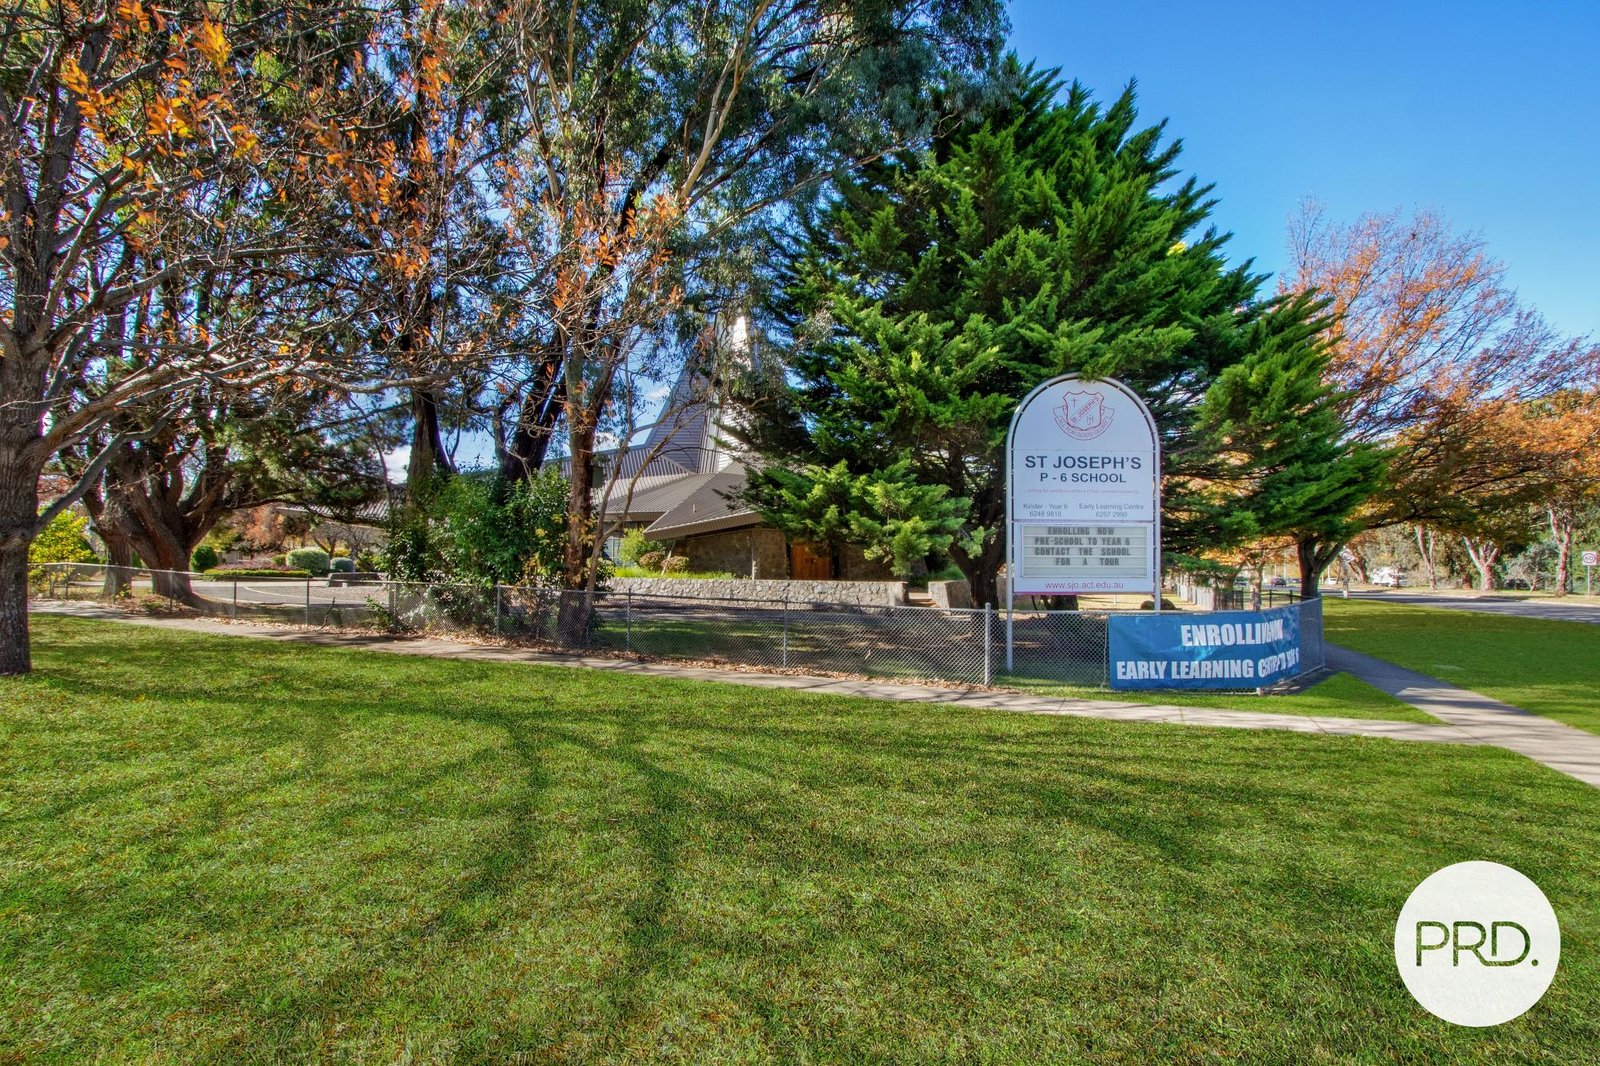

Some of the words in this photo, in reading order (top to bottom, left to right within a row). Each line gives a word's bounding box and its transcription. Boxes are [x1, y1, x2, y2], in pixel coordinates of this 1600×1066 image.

[1025, 455, 1048, 468] ST
[1053, 456, 1142, 470] JOSEPH'S
[1040, 472, 1048, 482] P
[1060, 472, 1067, 483] 6
[1071, 473, 1127, 483] SCHOOL
[1096, 503, 1122, 511] Learning
[1048, 527, 1090, 535] ENROLLING
[1097, 527, 1115, 535] NOW
[1035, 537, 1084, 546] PRE-SCHOOL
[1088, 537, 1098, 546] TO
[1102, 537, 1122, 546] YEAR
[1035, 547, 1071, 556] CONTACT
[1079, 547, 1093, 556] THE
[1101, 547, 1131, 556] SCHOOL
[1056, 557, 1071, 566] FOR
[1082, 557, 1088, 566] A
[1100, 557, 1120, 566] TOUR
[1045, 581, 1124, 590] www.sjo.act.edu.au
[1116, 661, 1167, 680] EARLY
[1171, 659, 1254, 679] LEARNING
